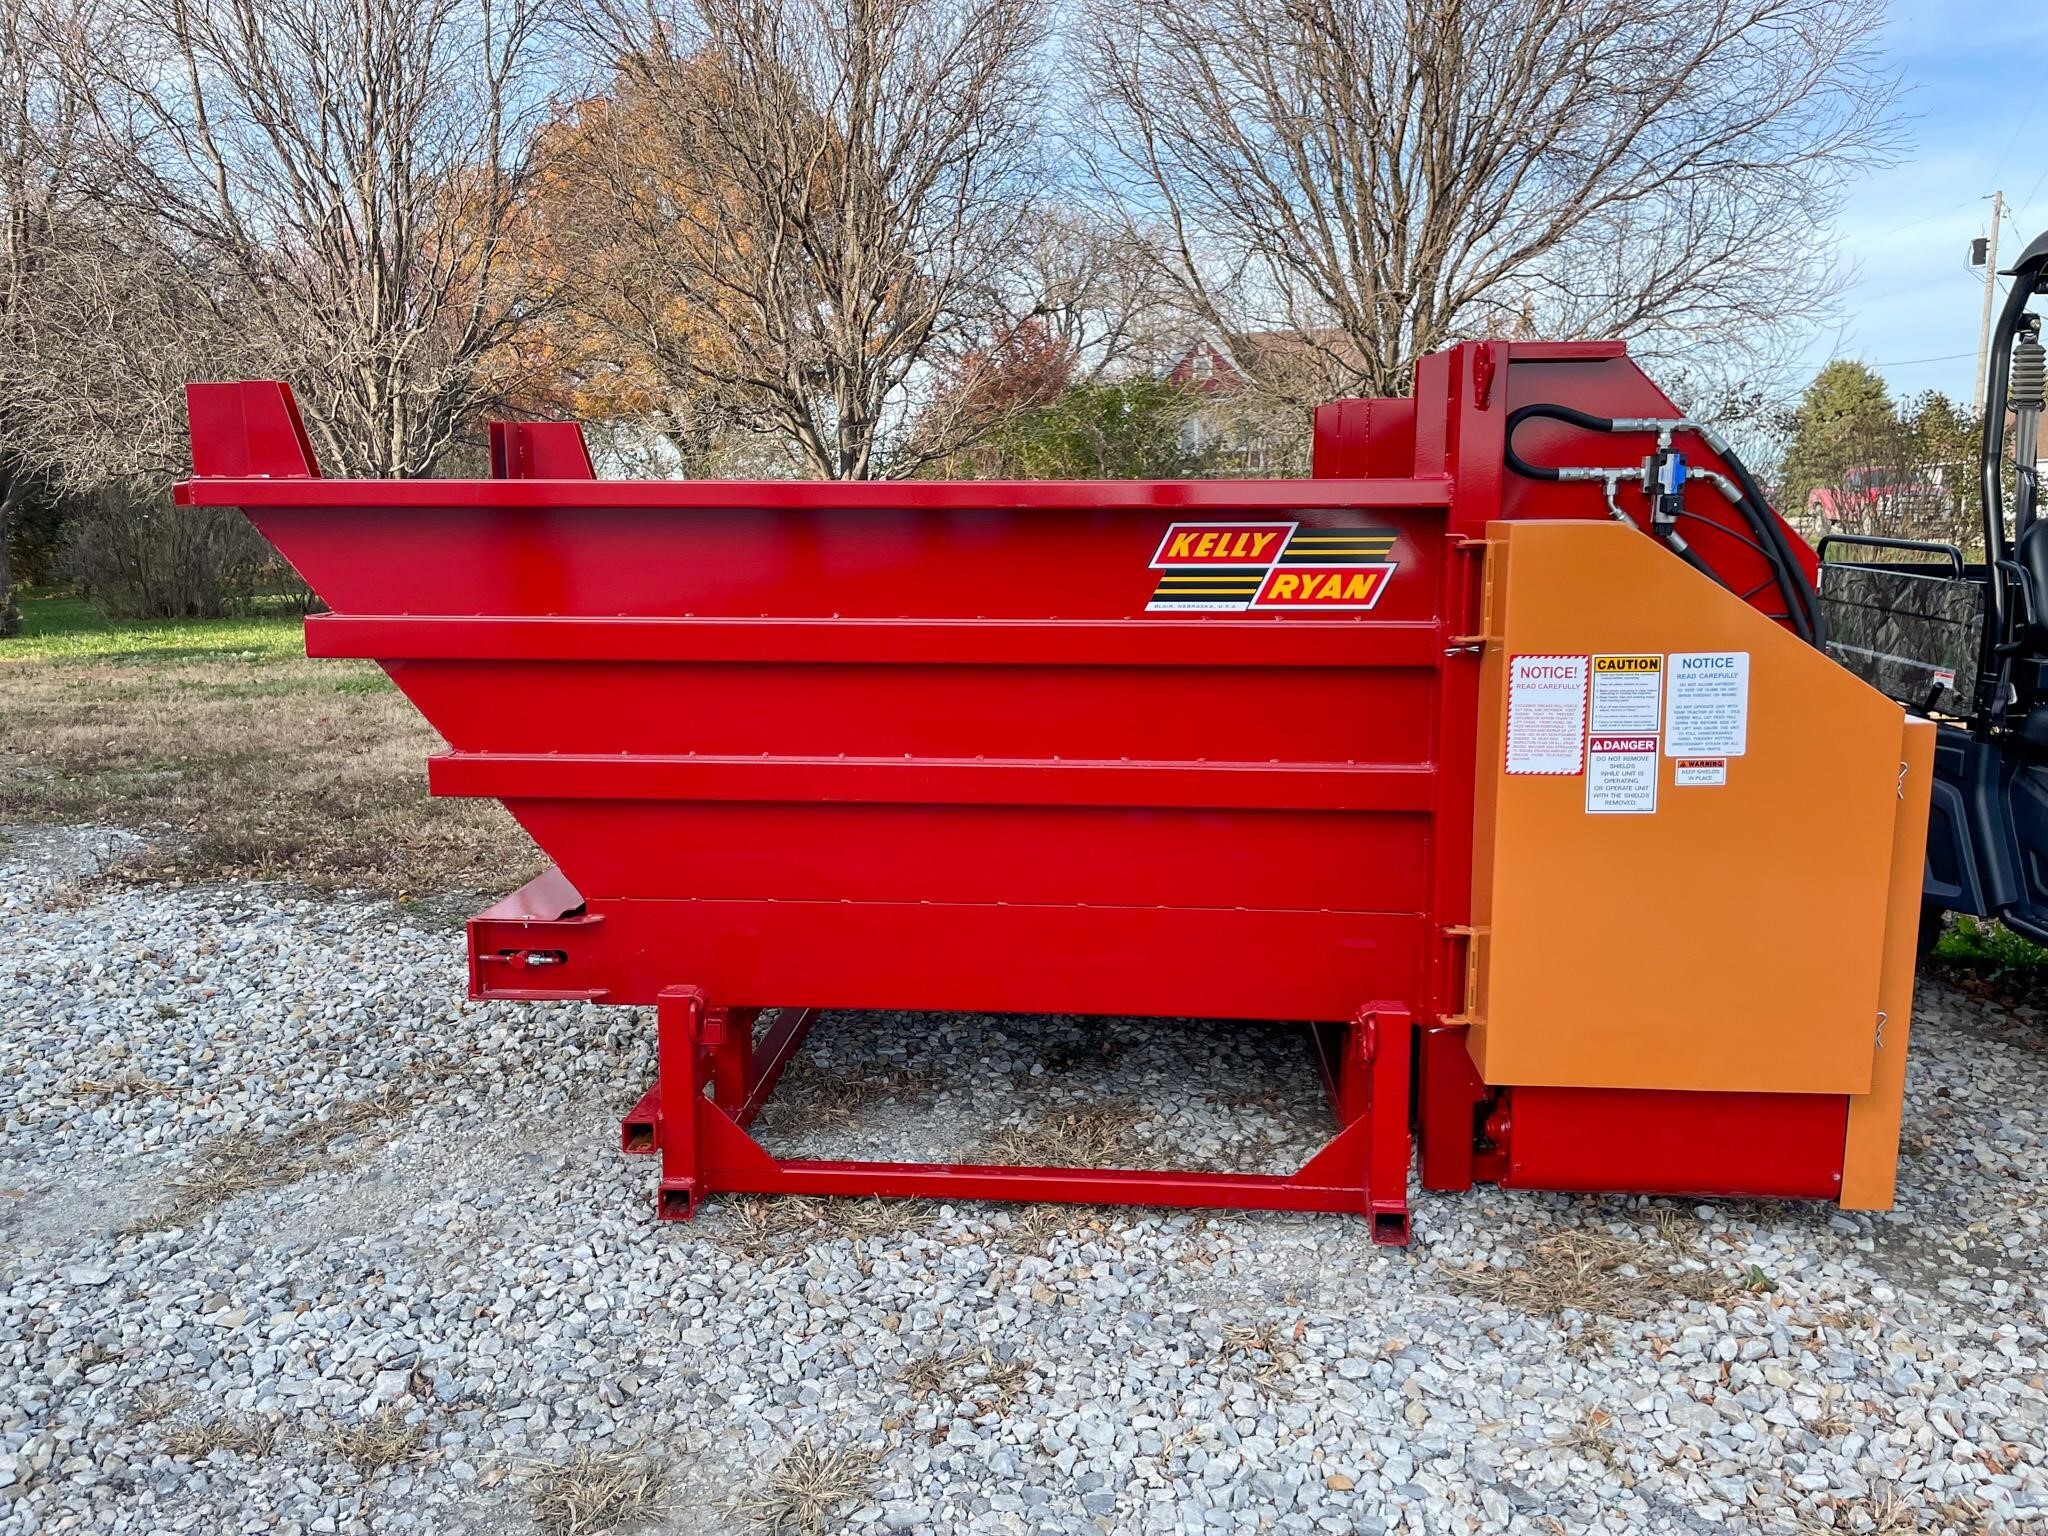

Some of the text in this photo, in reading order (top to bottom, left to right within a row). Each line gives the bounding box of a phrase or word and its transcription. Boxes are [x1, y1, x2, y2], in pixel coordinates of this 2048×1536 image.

[1168, 533, 1278, 557] KELLY
[1267, 574, 1377, 599] RYAN
[1597, 659, 1658, 670] CAUTION
[1682, 657, 1734, 669] NOTICE
[1521, 666, 1577, 679] NOTICE!
[1603, 740, 1655, 751] DANGER
[1688, 760, 1723, 768] WARNING
